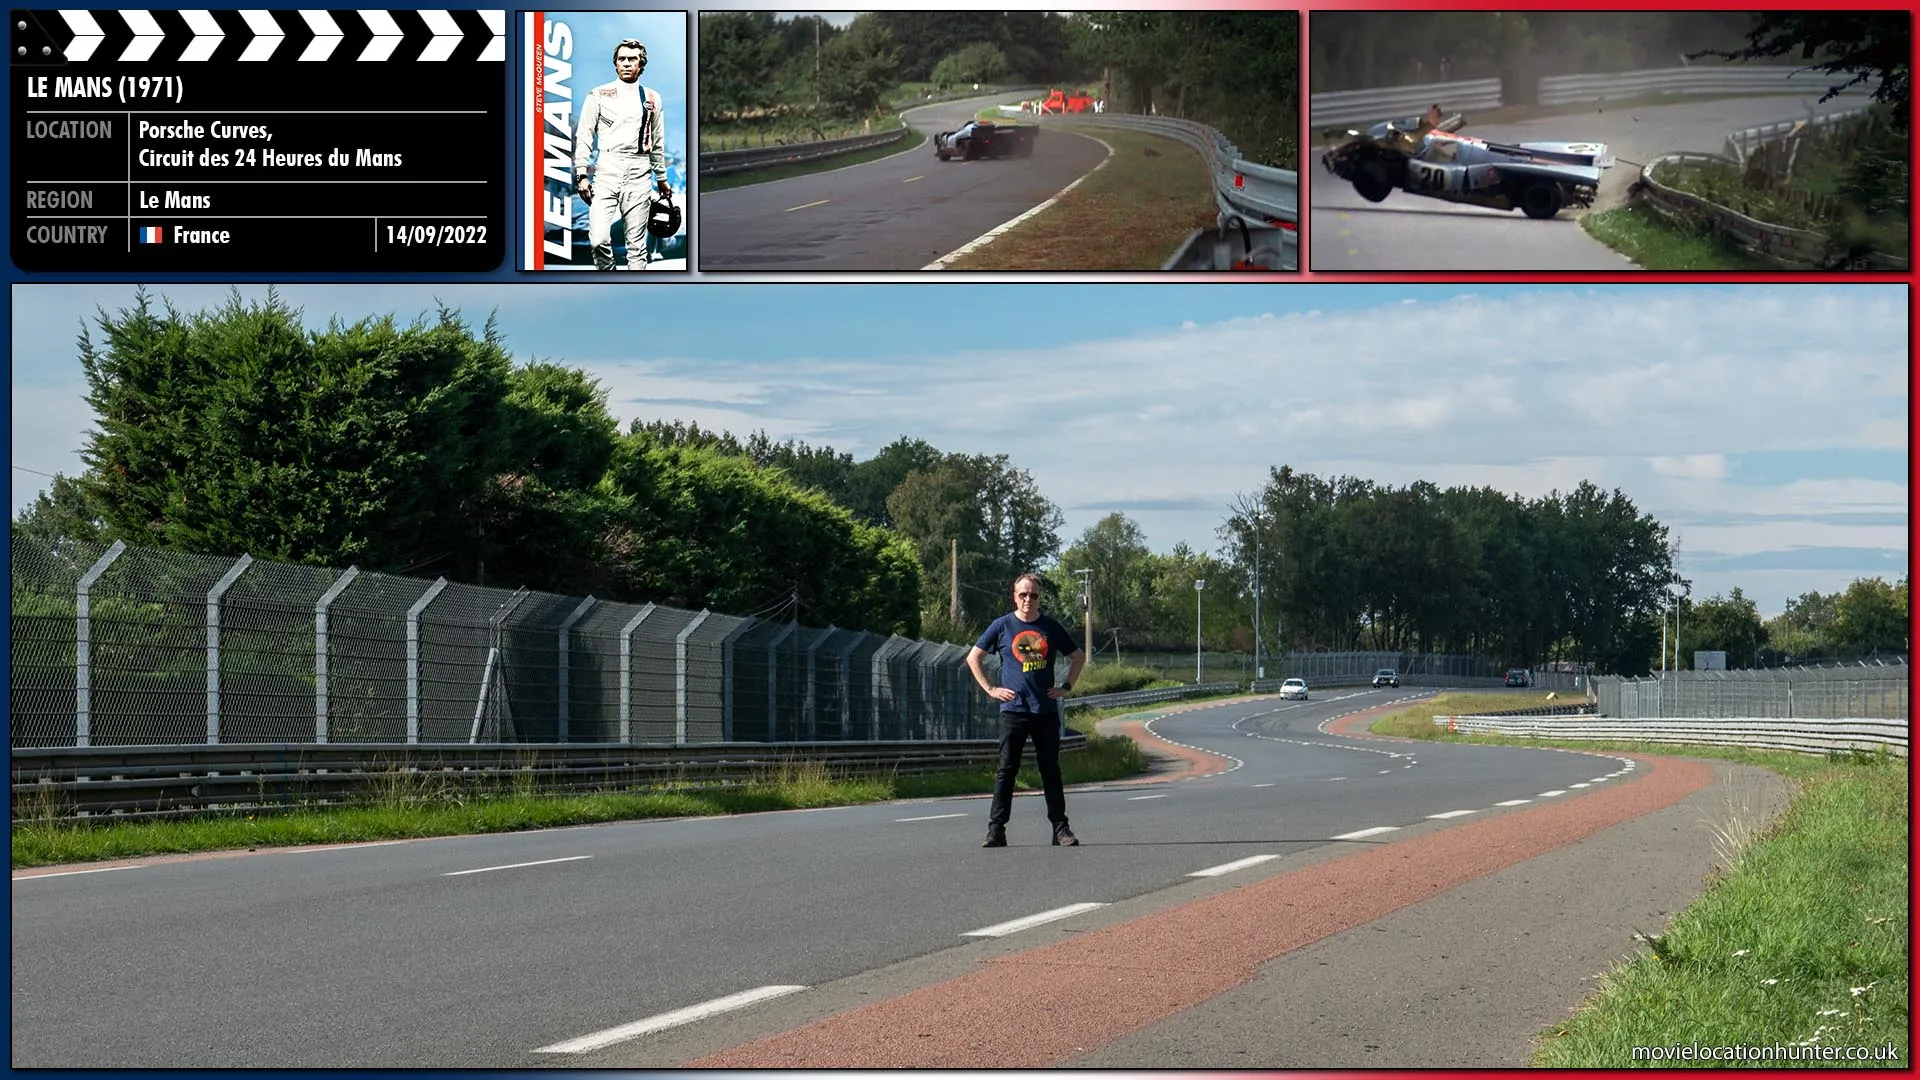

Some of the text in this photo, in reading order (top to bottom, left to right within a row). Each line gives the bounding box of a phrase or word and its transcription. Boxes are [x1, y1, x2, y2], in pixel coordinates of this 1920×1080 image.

[544, 20, 573, 260] LE MANS
[1420, 166, 1445, 190] 20
